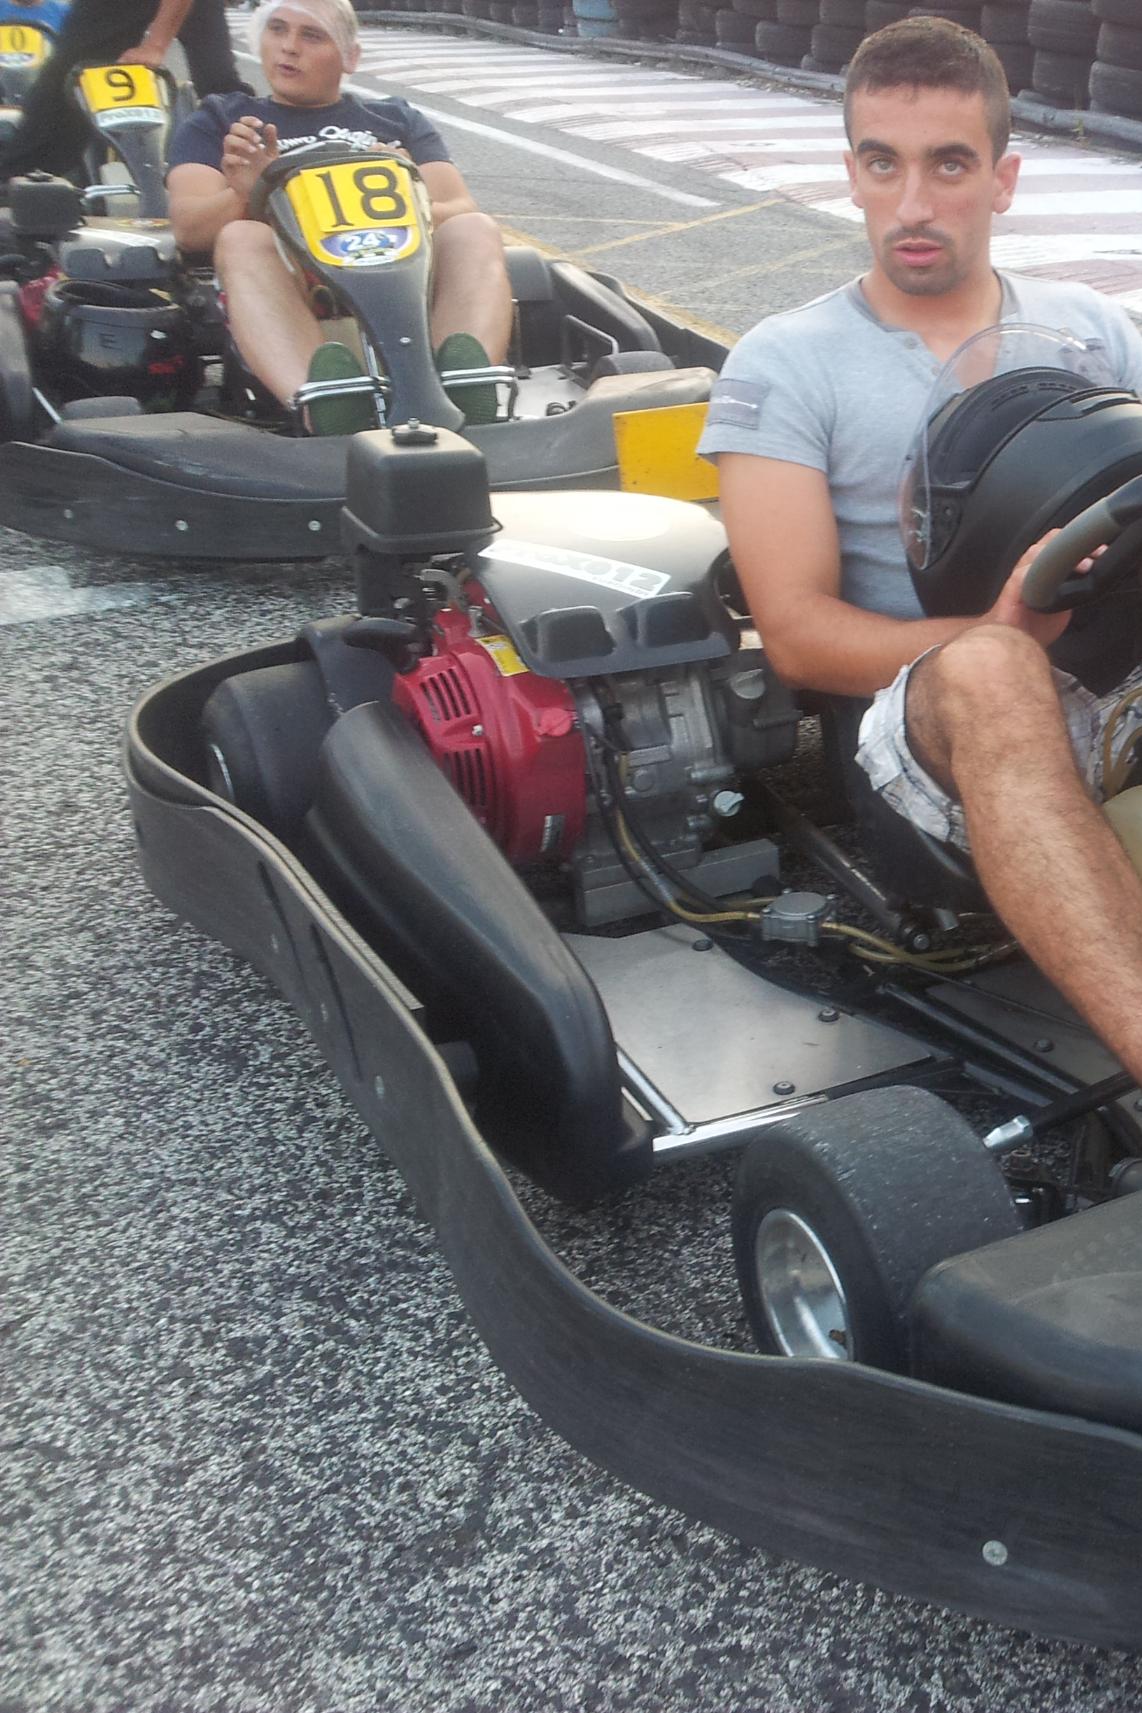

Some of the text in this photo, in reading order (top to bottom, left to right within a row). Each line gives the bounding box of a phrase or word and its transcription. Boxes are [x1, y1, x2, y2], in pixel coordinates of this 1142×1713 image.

[106, 69, 136, 102] 9
[316, 166, 407, 228] 18
[347, 232, 381, 252] 24
